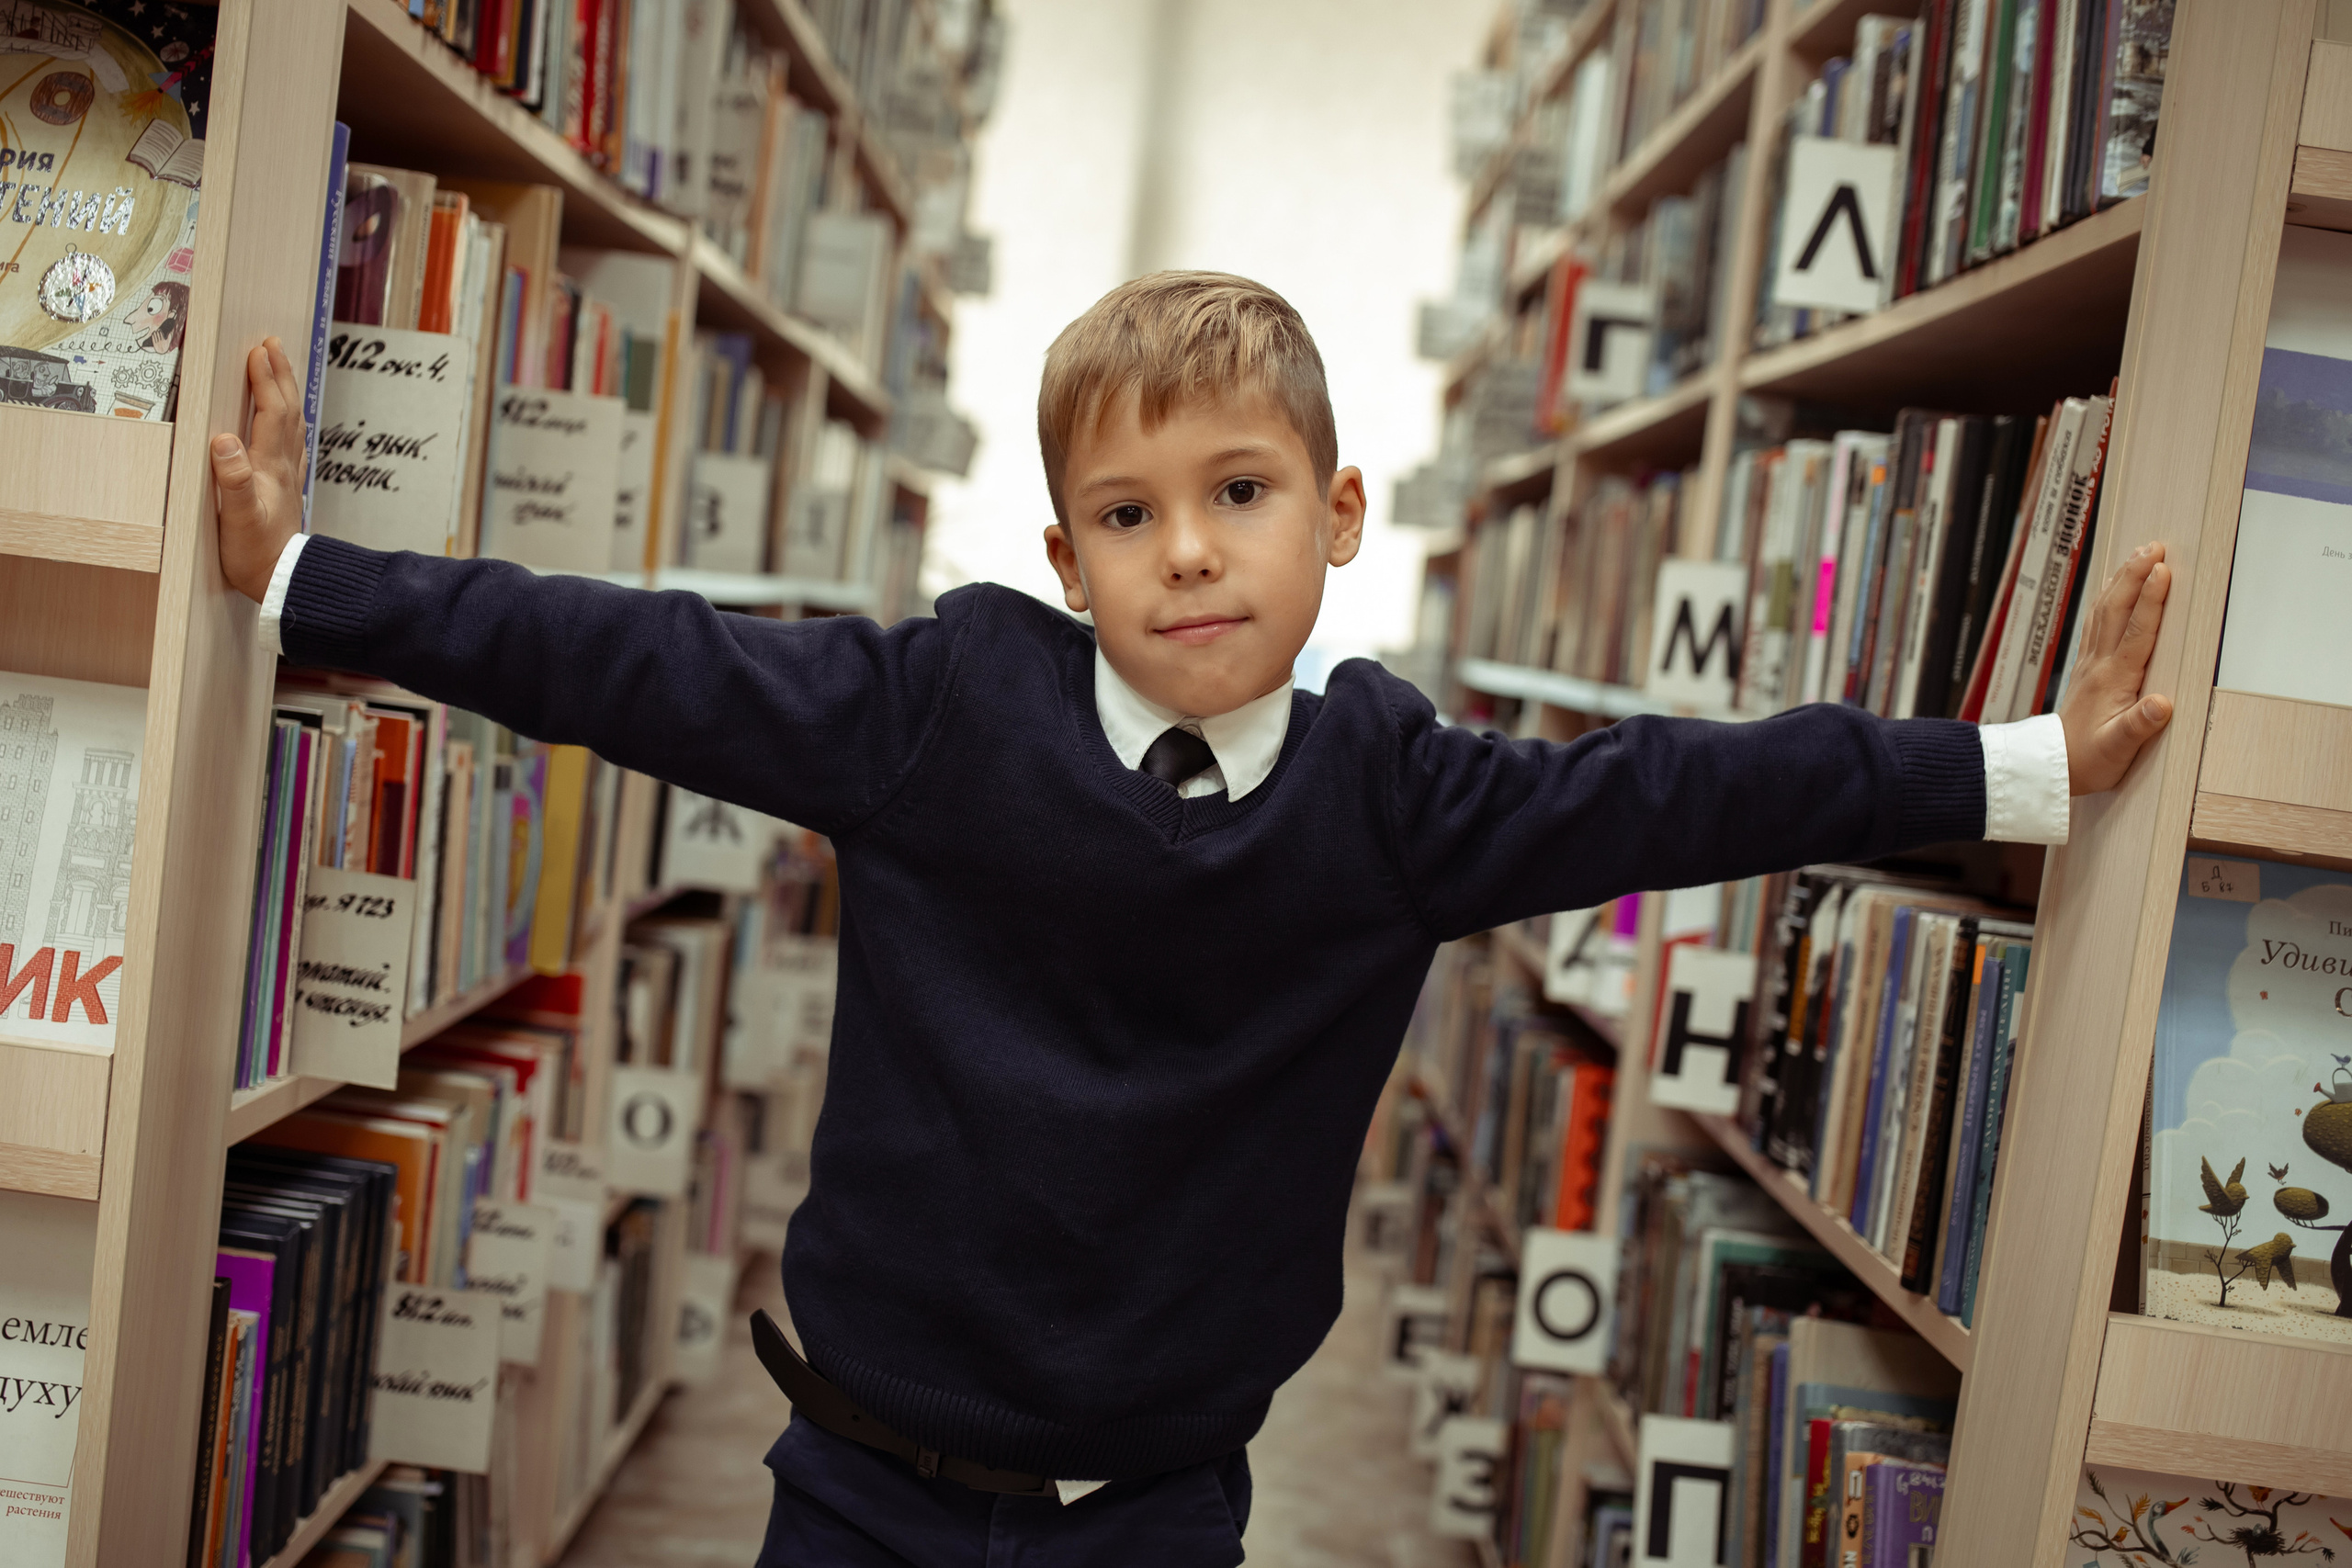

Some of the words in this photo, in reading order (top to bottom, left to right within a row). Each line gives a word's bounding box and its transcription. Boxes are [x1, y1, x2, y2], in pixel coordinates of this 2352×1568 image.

[1792, 185, 1877, 279] Л
[2322, 546, 2346, 559] День
[1661, 593, 1741, 680] М
[1662, 990, 1751, 1086] Н
[624, 1091, 673, 1149] О
[1532, 1269, 1600, 1341] О
[0, 1489, 65, 1506] ешествуют
[6, 1505, 62, 1520] растения
[1647, 1460, 1735, 1566] П
